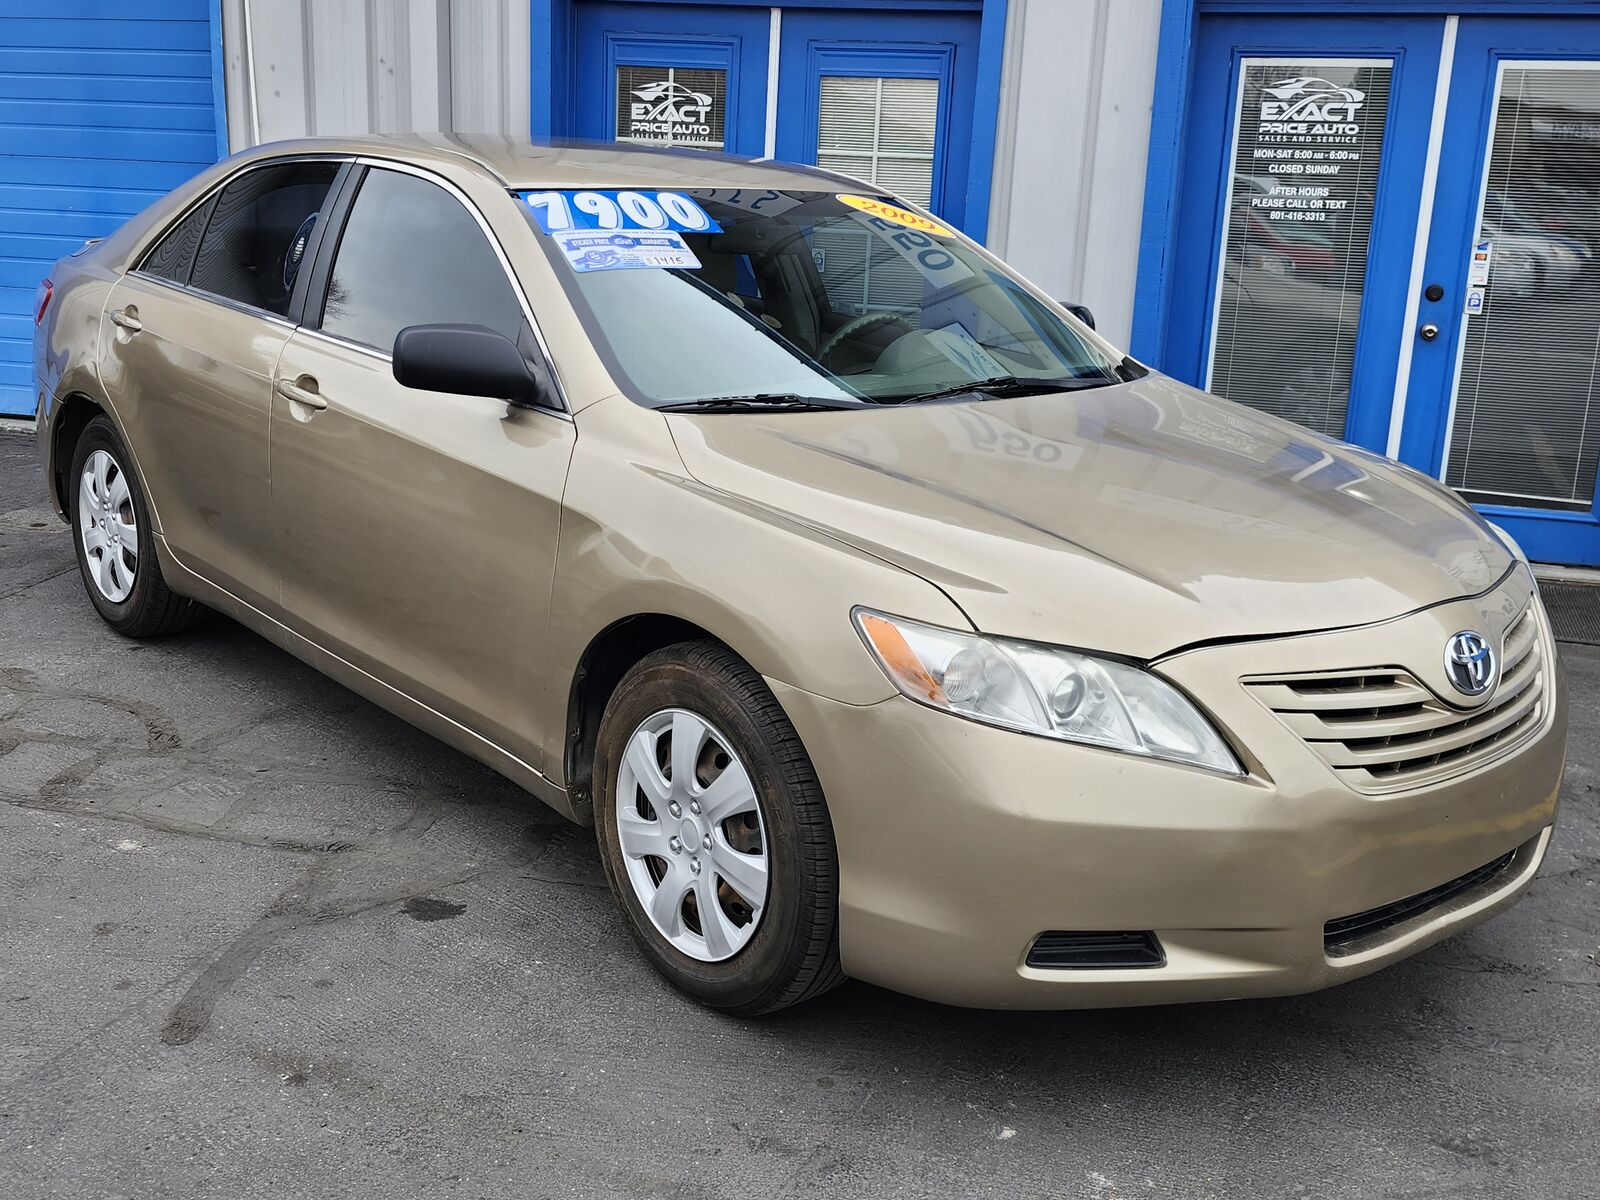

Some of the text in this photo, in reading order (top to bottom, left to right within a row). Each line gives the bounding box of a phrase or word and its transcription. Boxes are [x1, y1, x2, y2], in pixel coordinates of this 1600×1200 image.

[631, 103, 712, 123] EXACT
[1260, 102, 1364, 121] EXACT
[631, 122, 710, 134] PRICE AUTO
[1259, 123, 1360, 135] PRICE AUTO
[1253, 149, 1293, 159] MON-SAT
[1294, 150, 1313, 159] 8:00
[1329, 151, 1348, 159] 6:00
[1268, 164, 1340, 174] CLOSED SUNDAY
[1269, 187, 1330, 196] AFTER HOURS
[1252, 199, 1348, 210] PLEASE CALL OR TEXT
[526, 192, 710, 231] 7900
